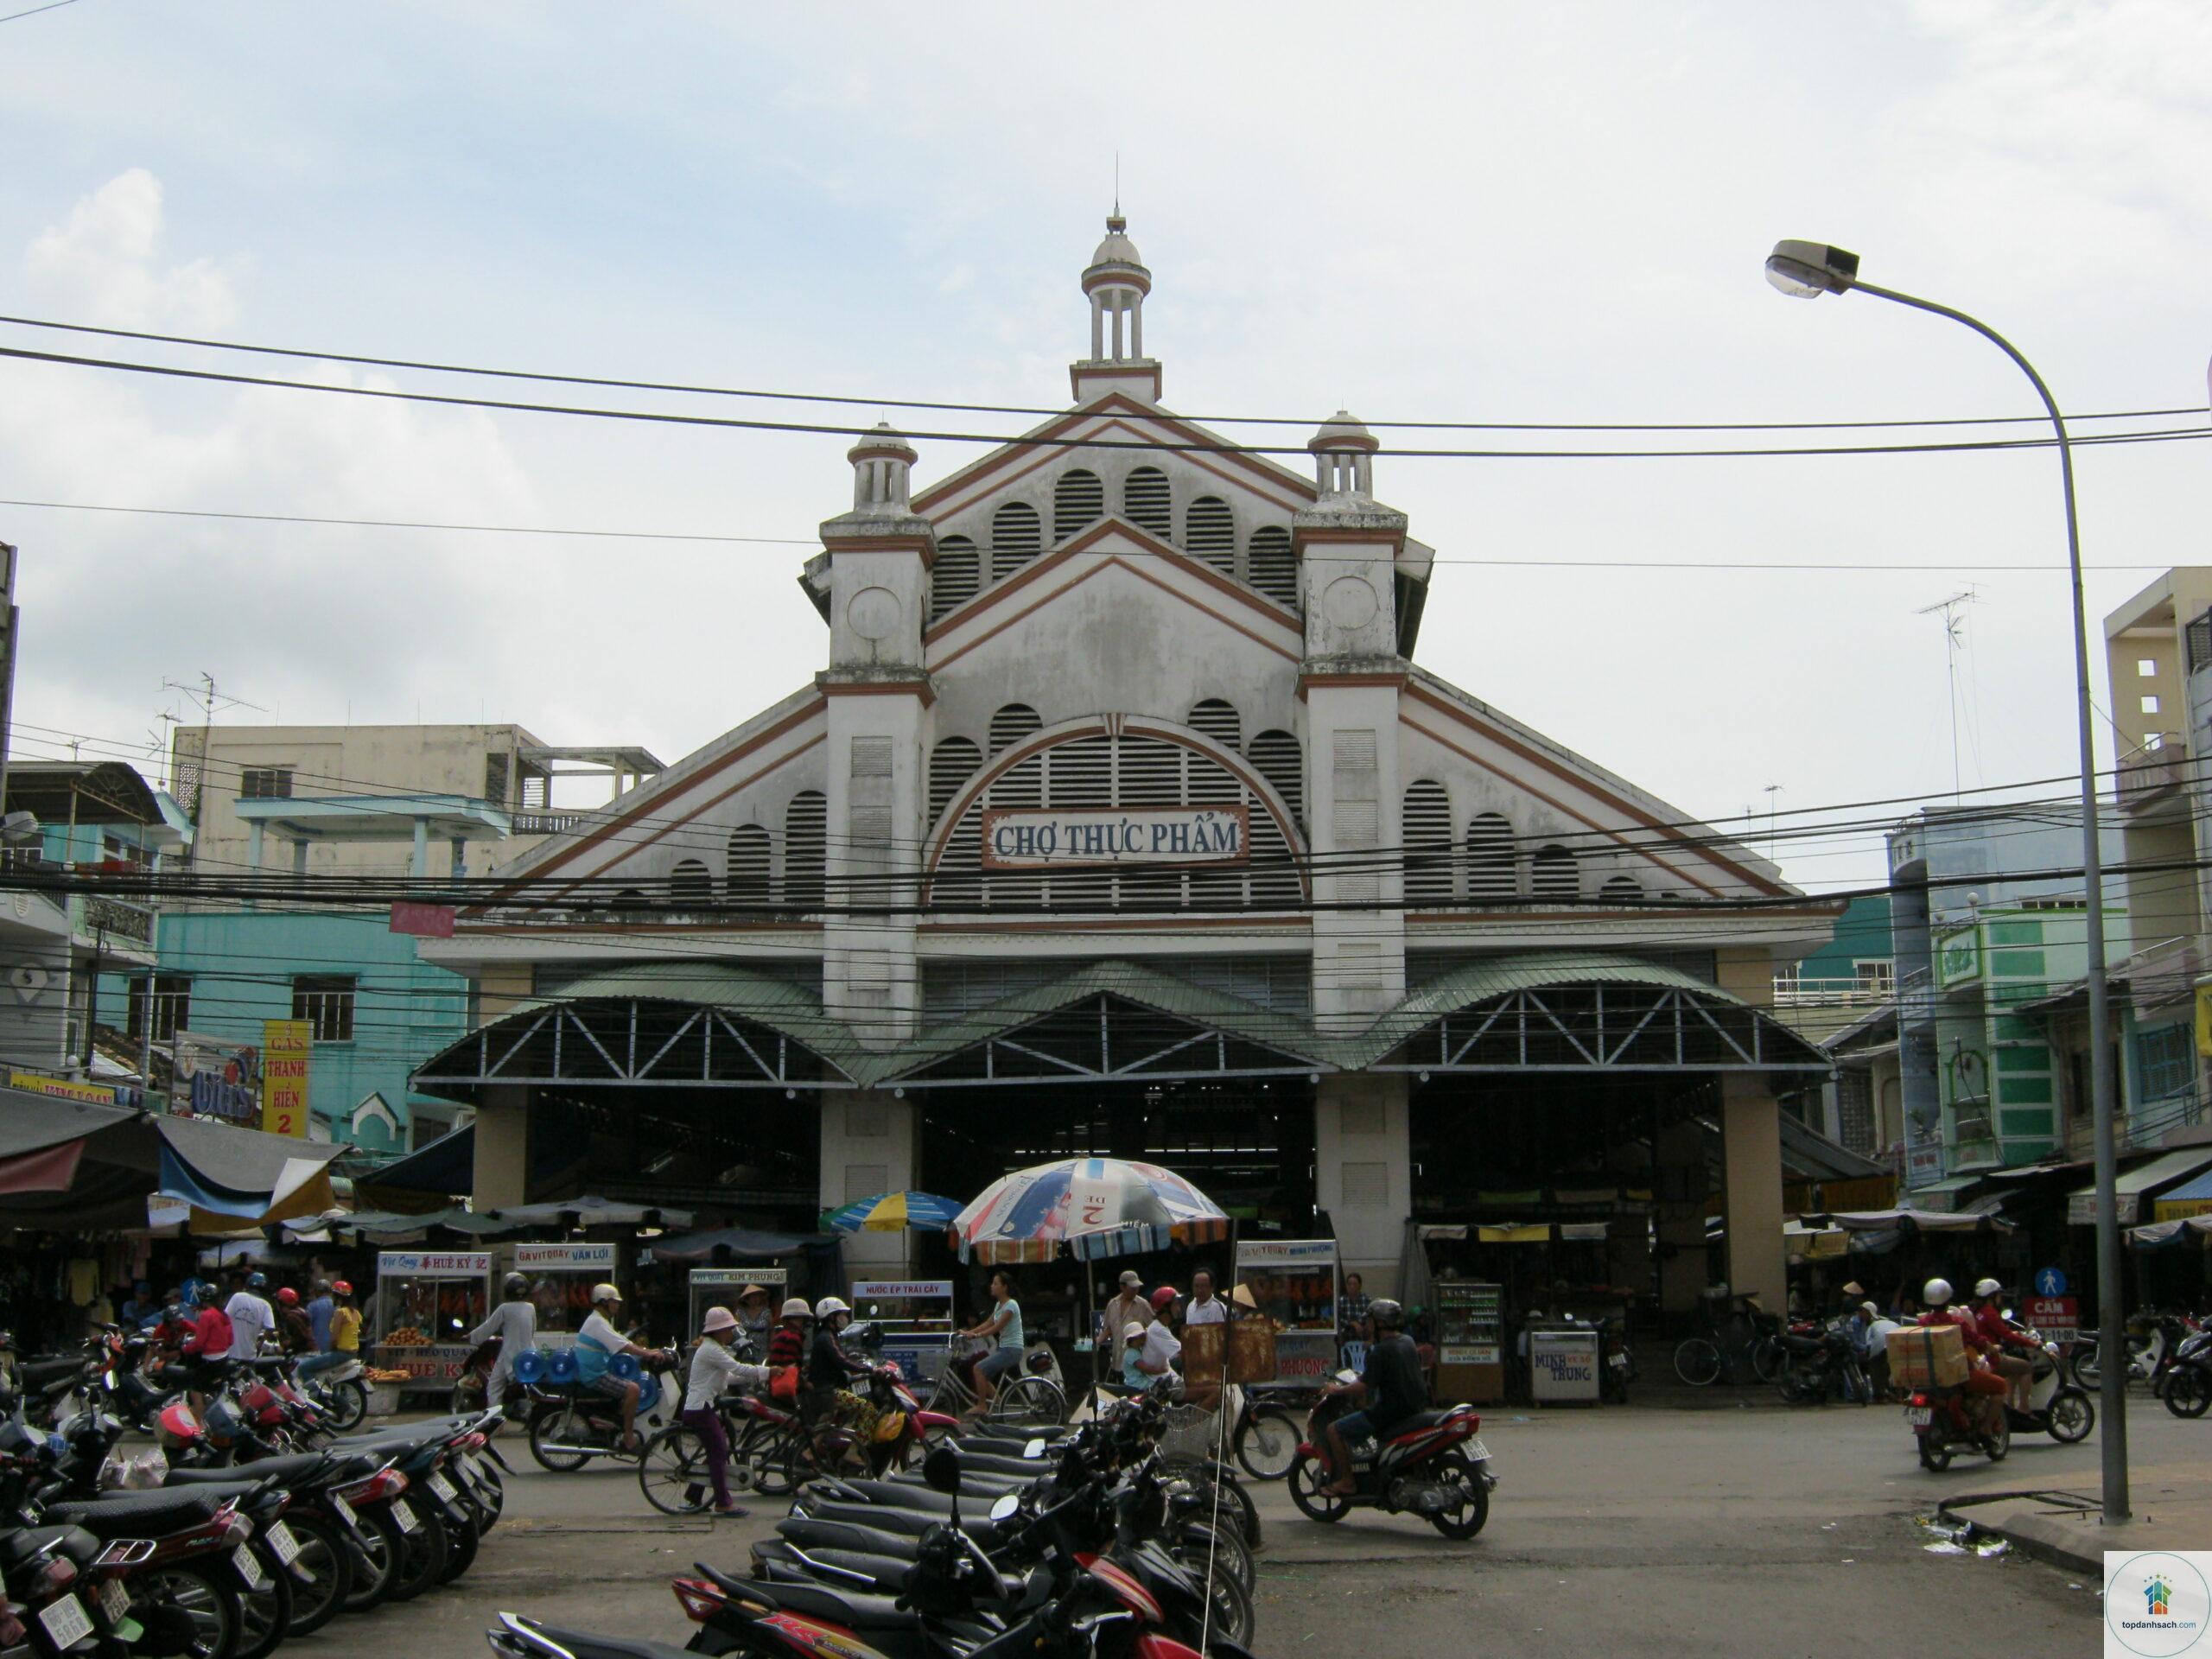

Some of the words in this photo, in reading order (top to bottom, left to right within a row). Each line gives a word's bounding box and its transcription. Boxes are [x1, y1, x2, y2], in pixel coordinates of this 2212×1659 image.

[995, 821, 1057, 862] CHỢ
[1065, 817, 1143, 861] THỰC
[1151, 812, 1238, 853] PHẨM
[270, 1037, 303, 1051] GAS
[268, 1060, 305, 1077] THANH
[276, 1114, 292, 1134] 2
[1550, 1367, 1592, 1381] TRUNG
